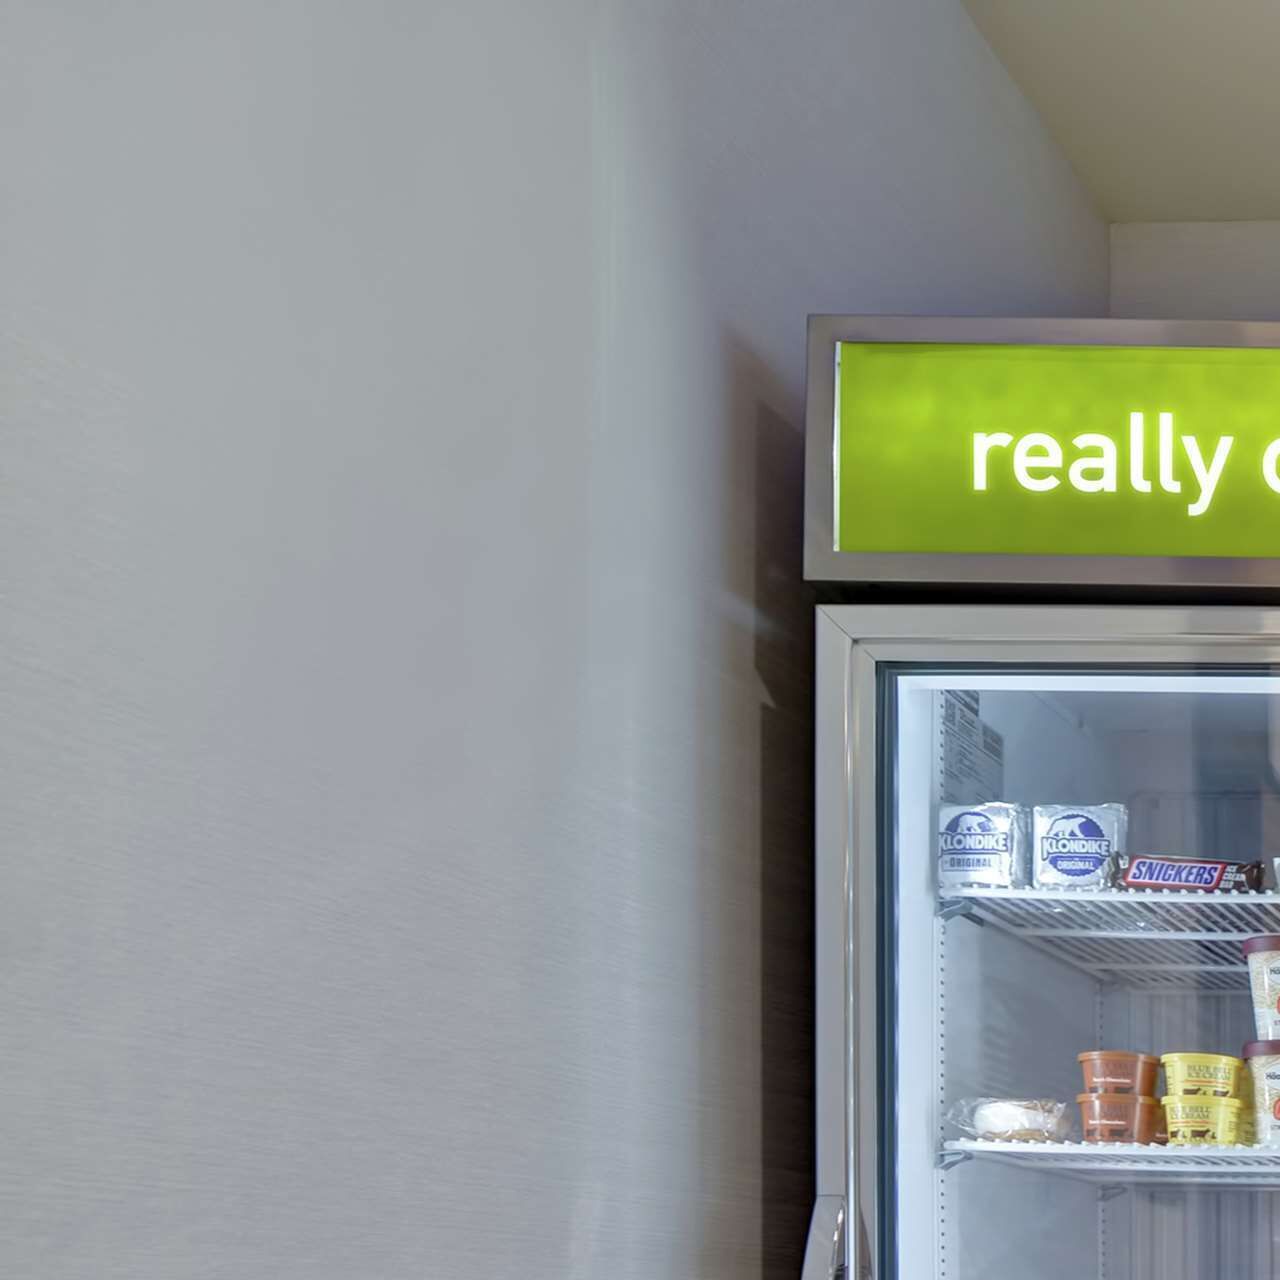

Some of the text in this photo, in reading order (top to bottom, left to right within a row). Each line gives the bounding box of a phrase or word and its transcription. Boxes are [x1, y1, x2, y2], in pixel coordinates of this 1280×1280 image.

[970, 410, 1233, 517] really
[938, 831, 1008, 856] KLONDIKE
[1041, 836, 1111, 861] KLONDIKE
[950, 857, 992, 868] ORIGINAL
[1056, 860, 1096, 871] ORIGINAL
[1130, 860, 1219, 885] SNICKERS
